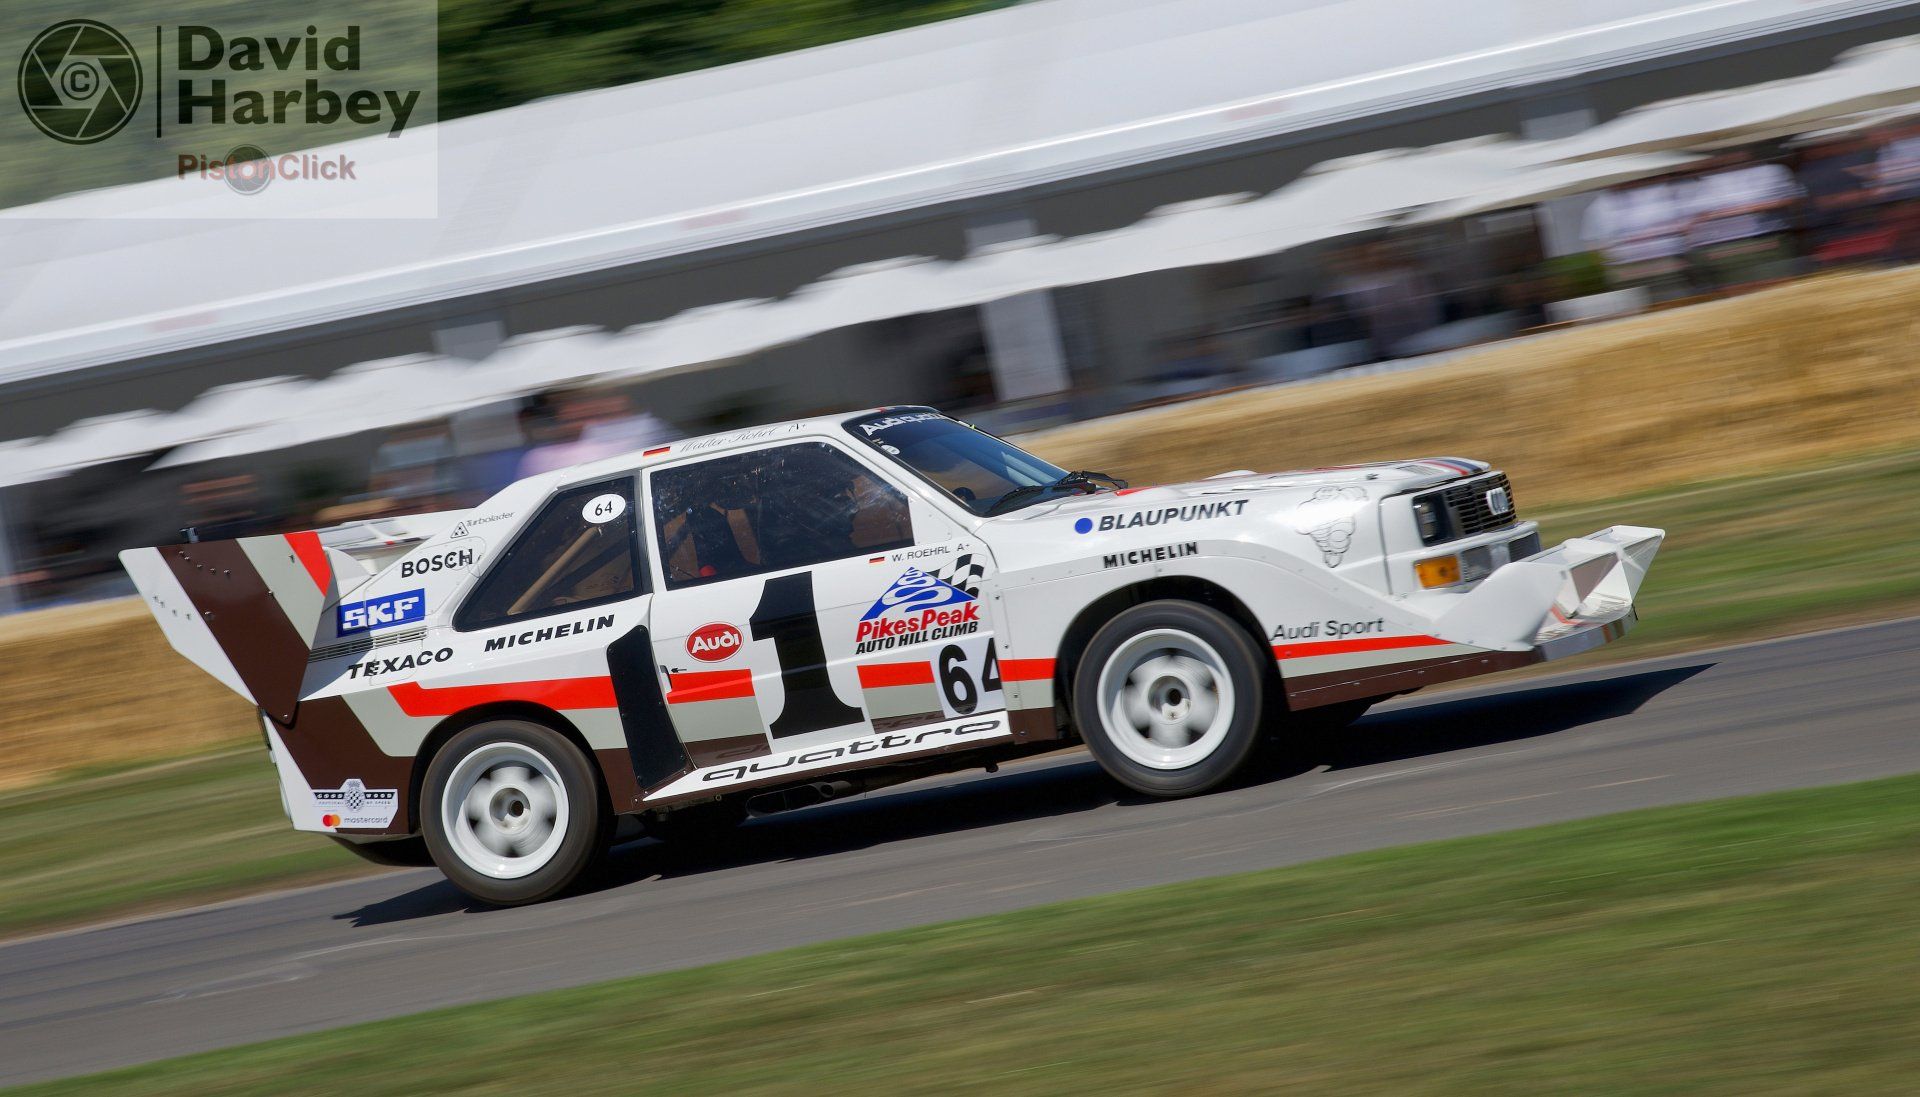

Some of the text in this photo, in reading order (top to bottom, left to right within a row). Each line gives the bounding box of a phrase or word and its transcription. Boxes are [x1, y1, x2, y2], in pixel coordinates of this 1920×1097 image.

[466, 511, 516, 527] Turbolader
[594, 501, 613, 516] 64
[1098, 499, 1249, 532] BLAUPUNKT
[401, 548, 473, 578] BOSCH
[892, 553, 904, 562] W.
[907, 545, 951, 560] ROEHRL
[1103, 541, 1199, 568] MICHELIN
[342, 596, 420, 630] SKF
[484, 614, 615, 652] MICHELIN
[855, 621, 978, 655] AUTO HILL CLIMB
[1272, 617, 1385, 643] Audi Sport
[347, 647, 454, 679] TEXACO
[749, 570, 866, 739] 1
[939, 637, 1002, 715] 64
[702, 720, 1001, 782] quattro
[344, 816, 388, 824] mastercard
